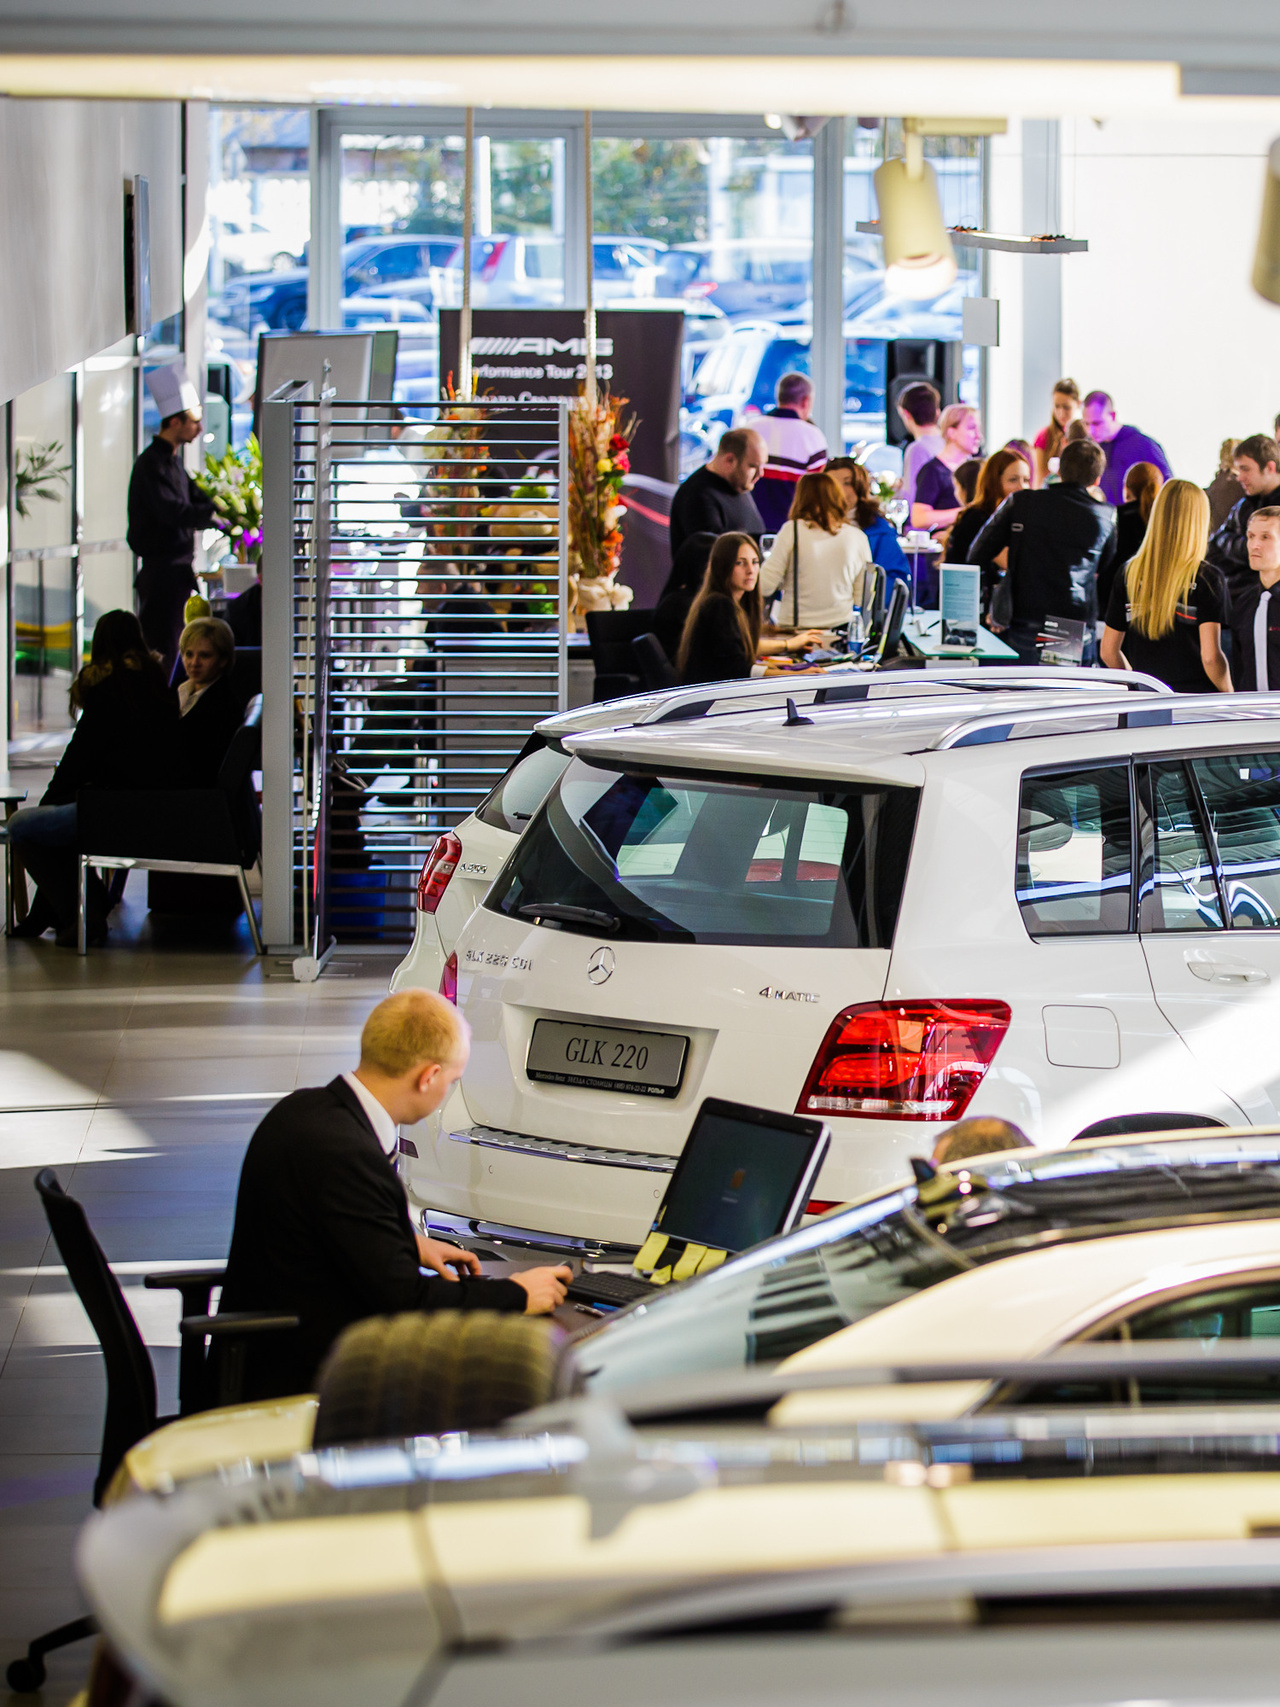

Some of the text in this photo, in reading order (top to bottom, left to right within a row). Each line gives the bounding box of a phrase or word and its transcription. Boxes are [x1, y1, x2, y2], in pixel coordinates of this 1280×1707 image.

[472, 363, 614, 380] erformance Tour 213
[566, 1037, 649, 1071] GLK 220
